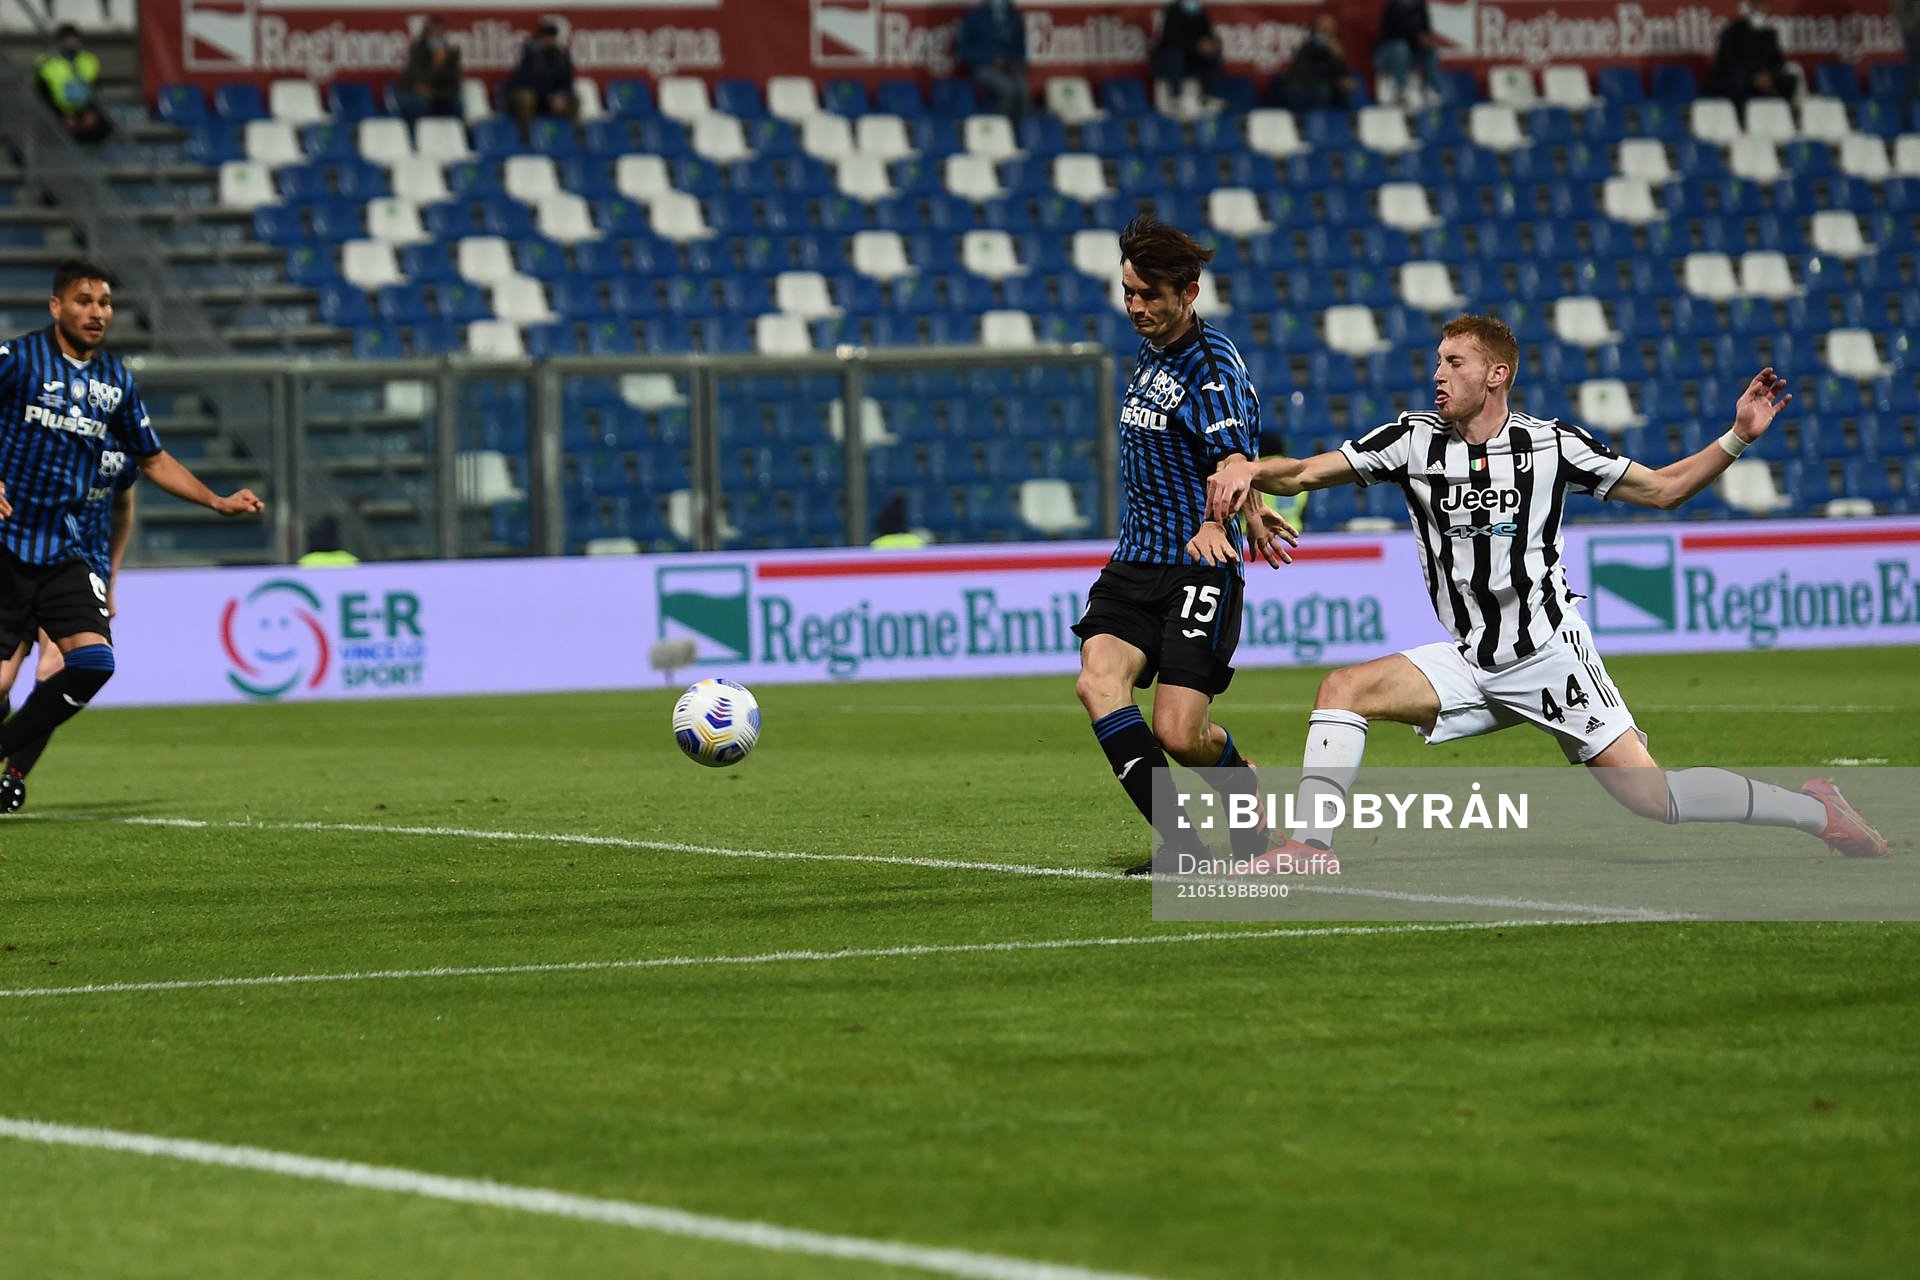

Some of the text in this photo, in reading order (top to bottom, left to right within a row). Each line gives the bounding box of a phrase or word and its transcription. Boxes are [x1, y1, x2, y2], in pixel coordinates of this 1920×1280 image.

[1441, 485, 1520, 514] Jeep
[1179, 585, 1221, 623] 15
[1541, 673, 1590, 724] 44
